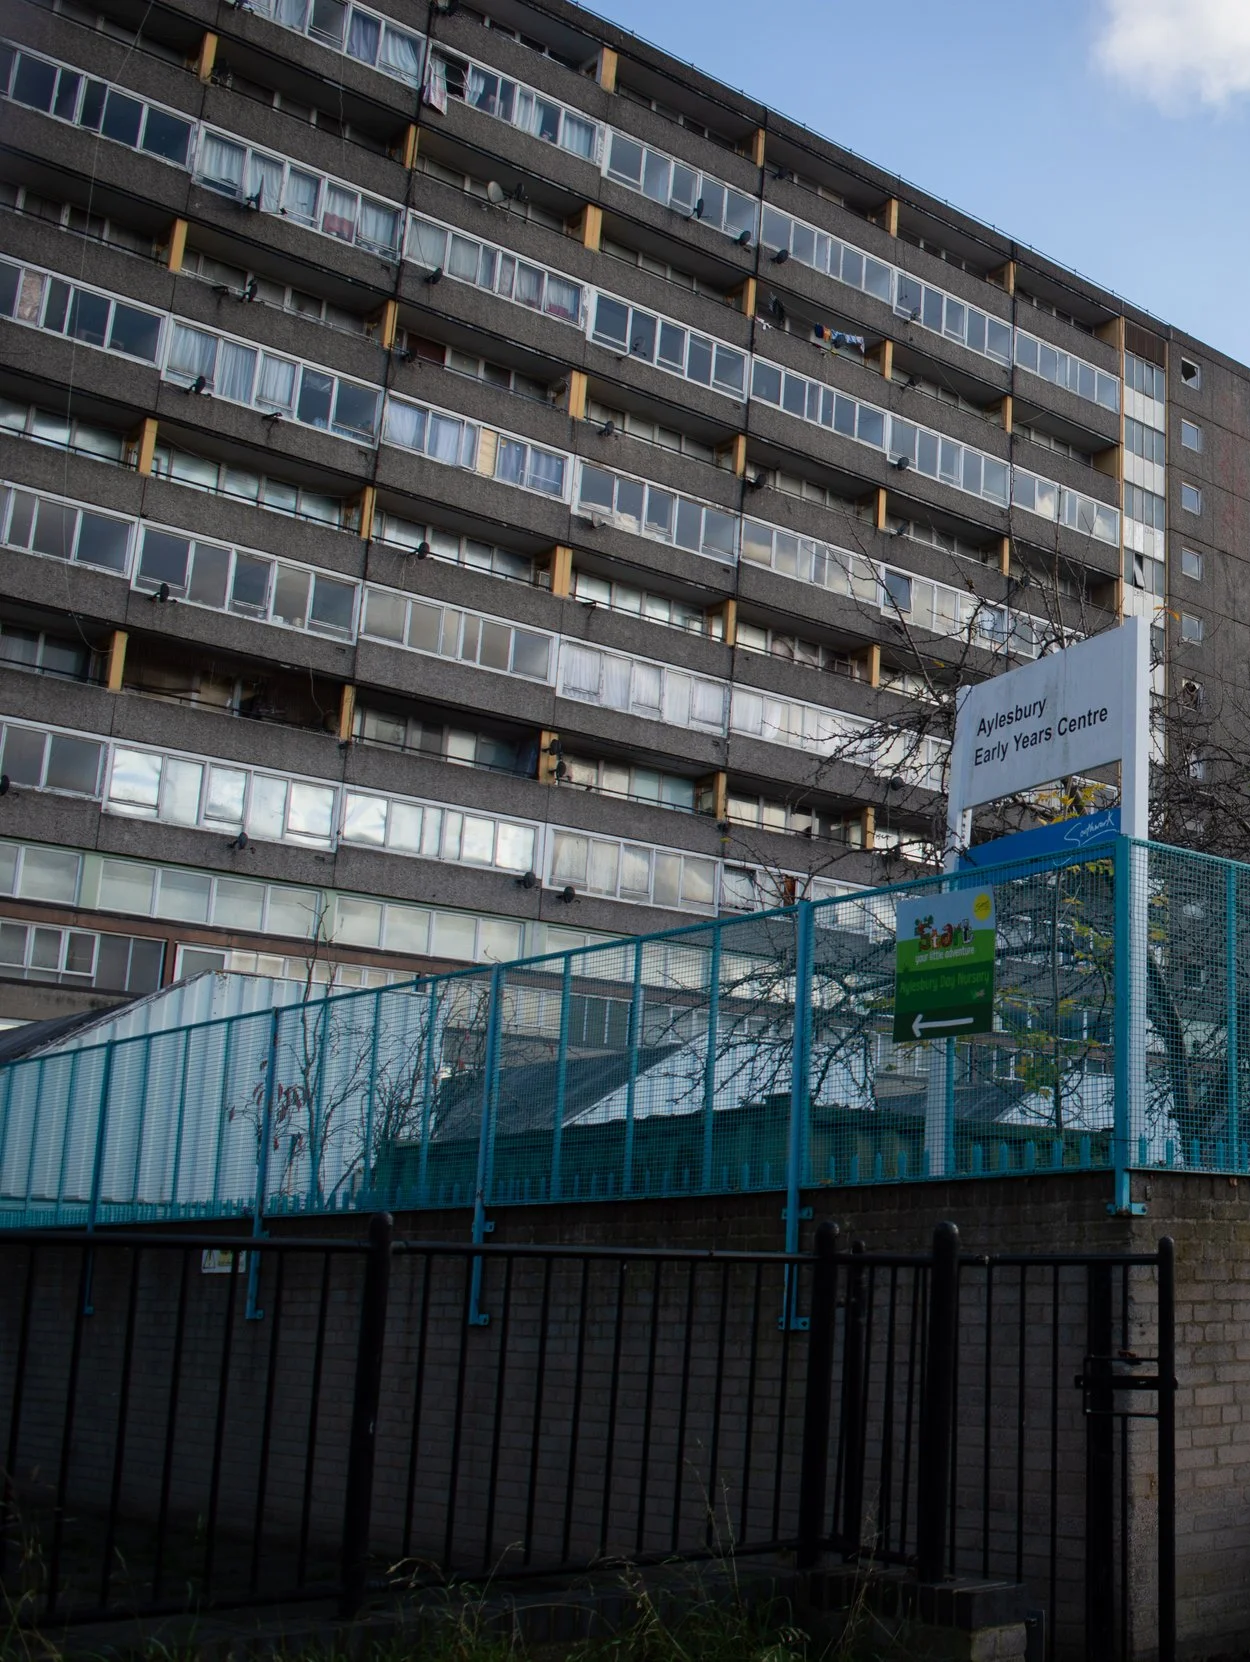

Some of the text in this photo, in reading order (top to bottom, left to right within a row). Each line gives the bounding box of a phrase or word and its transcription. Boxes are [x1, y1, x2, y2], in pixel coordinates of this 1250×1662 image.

[974, 707, 1108, 766] Early Years Centre
[977, 698, 1047, 737] Aylesbury
[900, 970, 990, 996] Aylesbury Day Nursery
